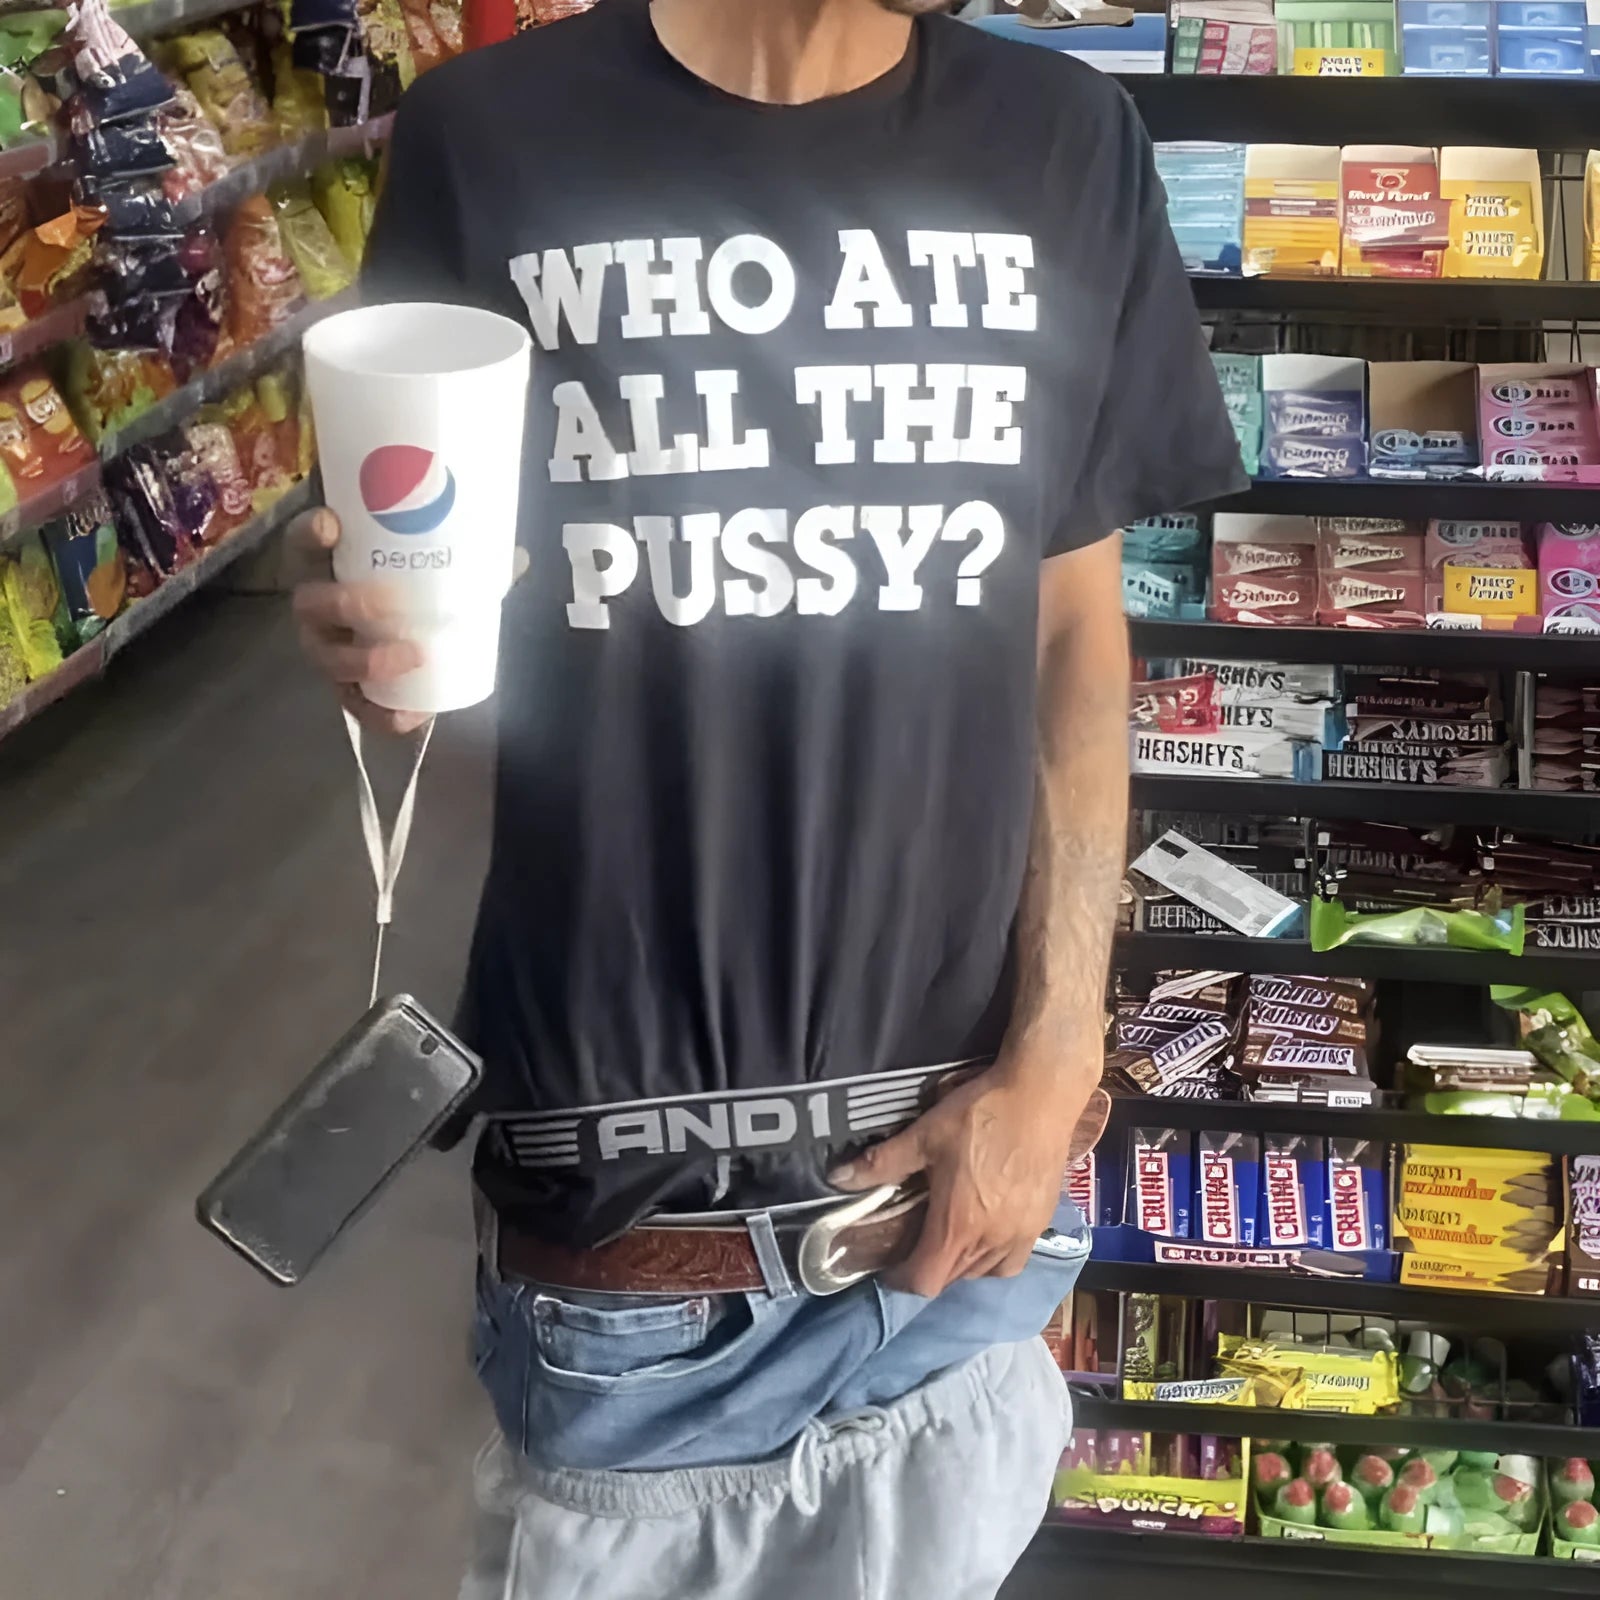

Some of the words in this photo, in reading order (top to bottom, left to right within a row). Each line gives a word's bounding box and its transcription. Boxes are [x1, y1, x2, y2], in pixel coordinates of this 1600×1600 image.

[509, 233, 796, 351] WHO
[824, 229, 1038, 331] ATE
[548, 369, 770, 482] ALL
[794, 363, 1027, 466] THE
[370, 546, 452, 571] pepsi
[562, 500, 1006, 630] PUSSY?
